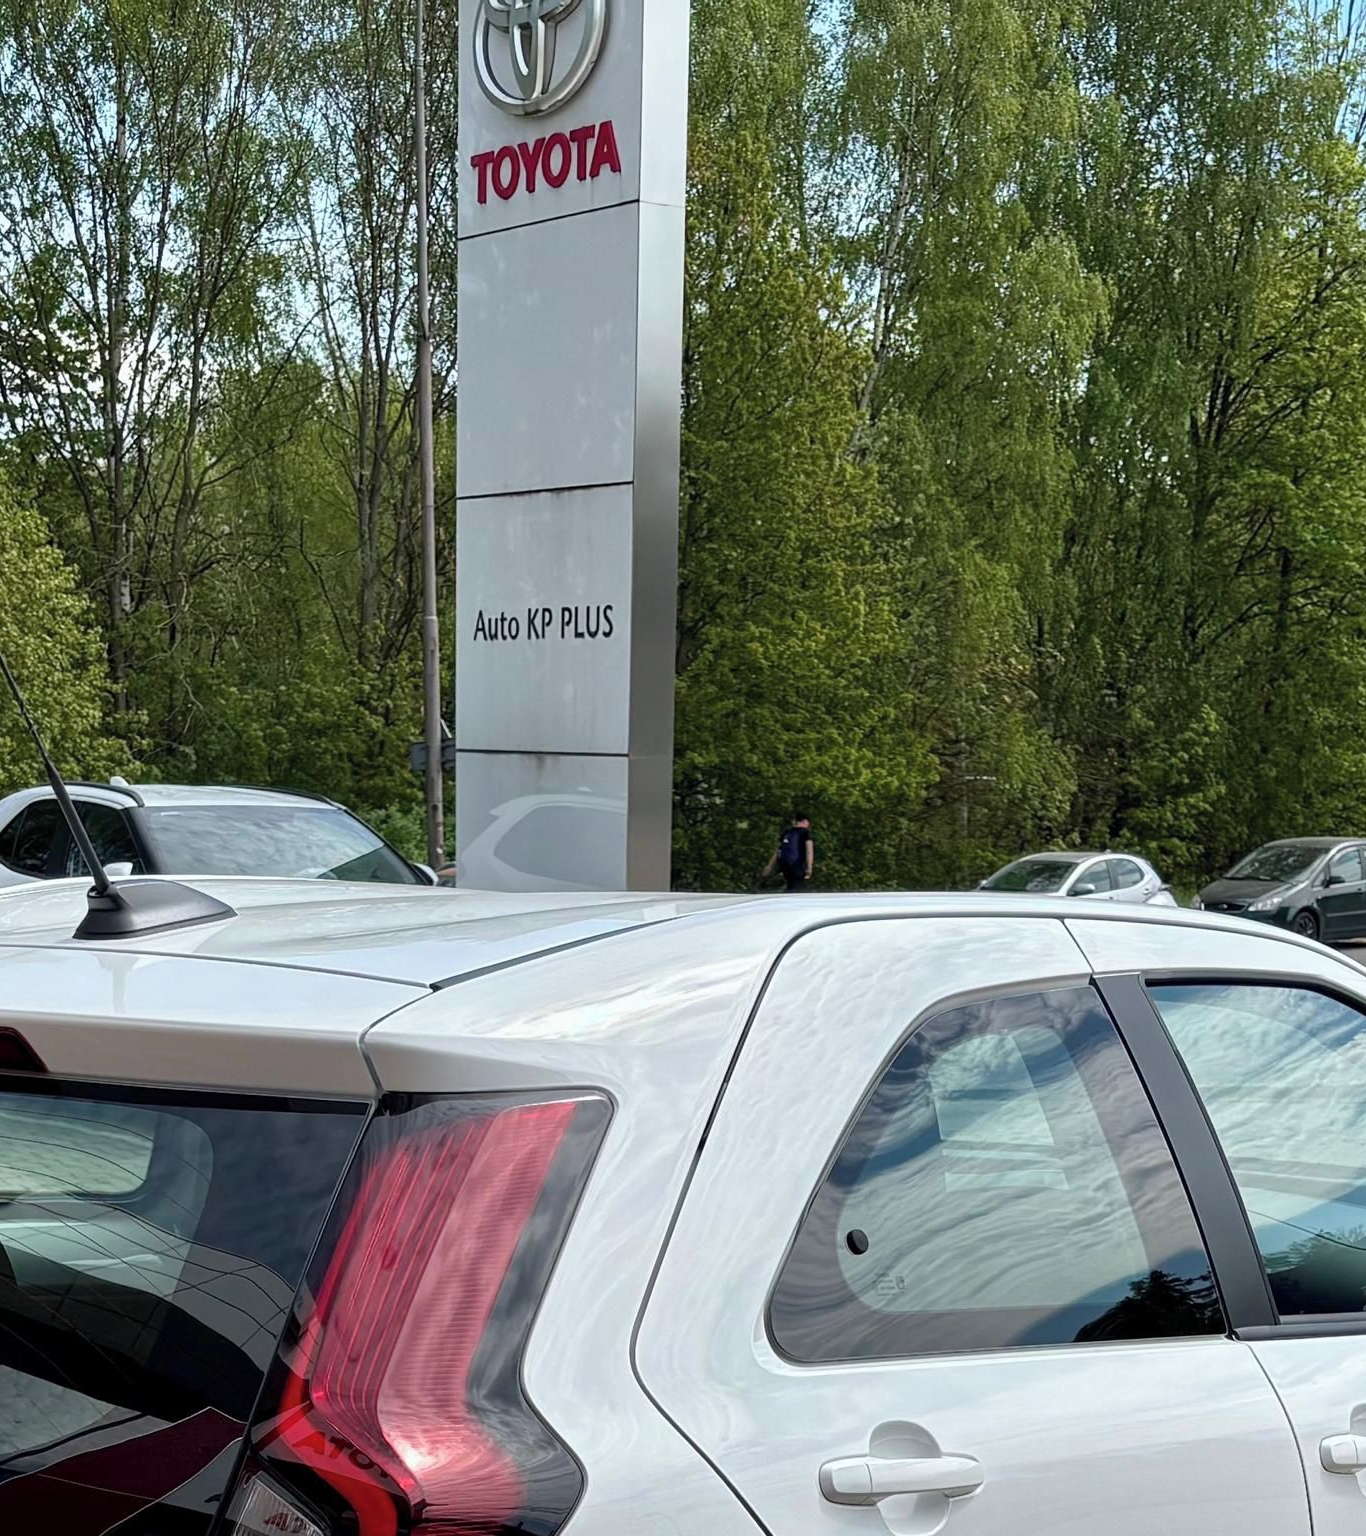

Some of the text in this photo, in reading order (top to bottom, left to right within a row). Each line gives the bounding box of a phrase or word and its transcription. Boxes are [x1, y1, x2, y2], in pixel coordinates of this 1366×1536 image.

[471, 120, 621, 205] TOYOTA
[473, 604, 614, 642] Auto KP PLUS
